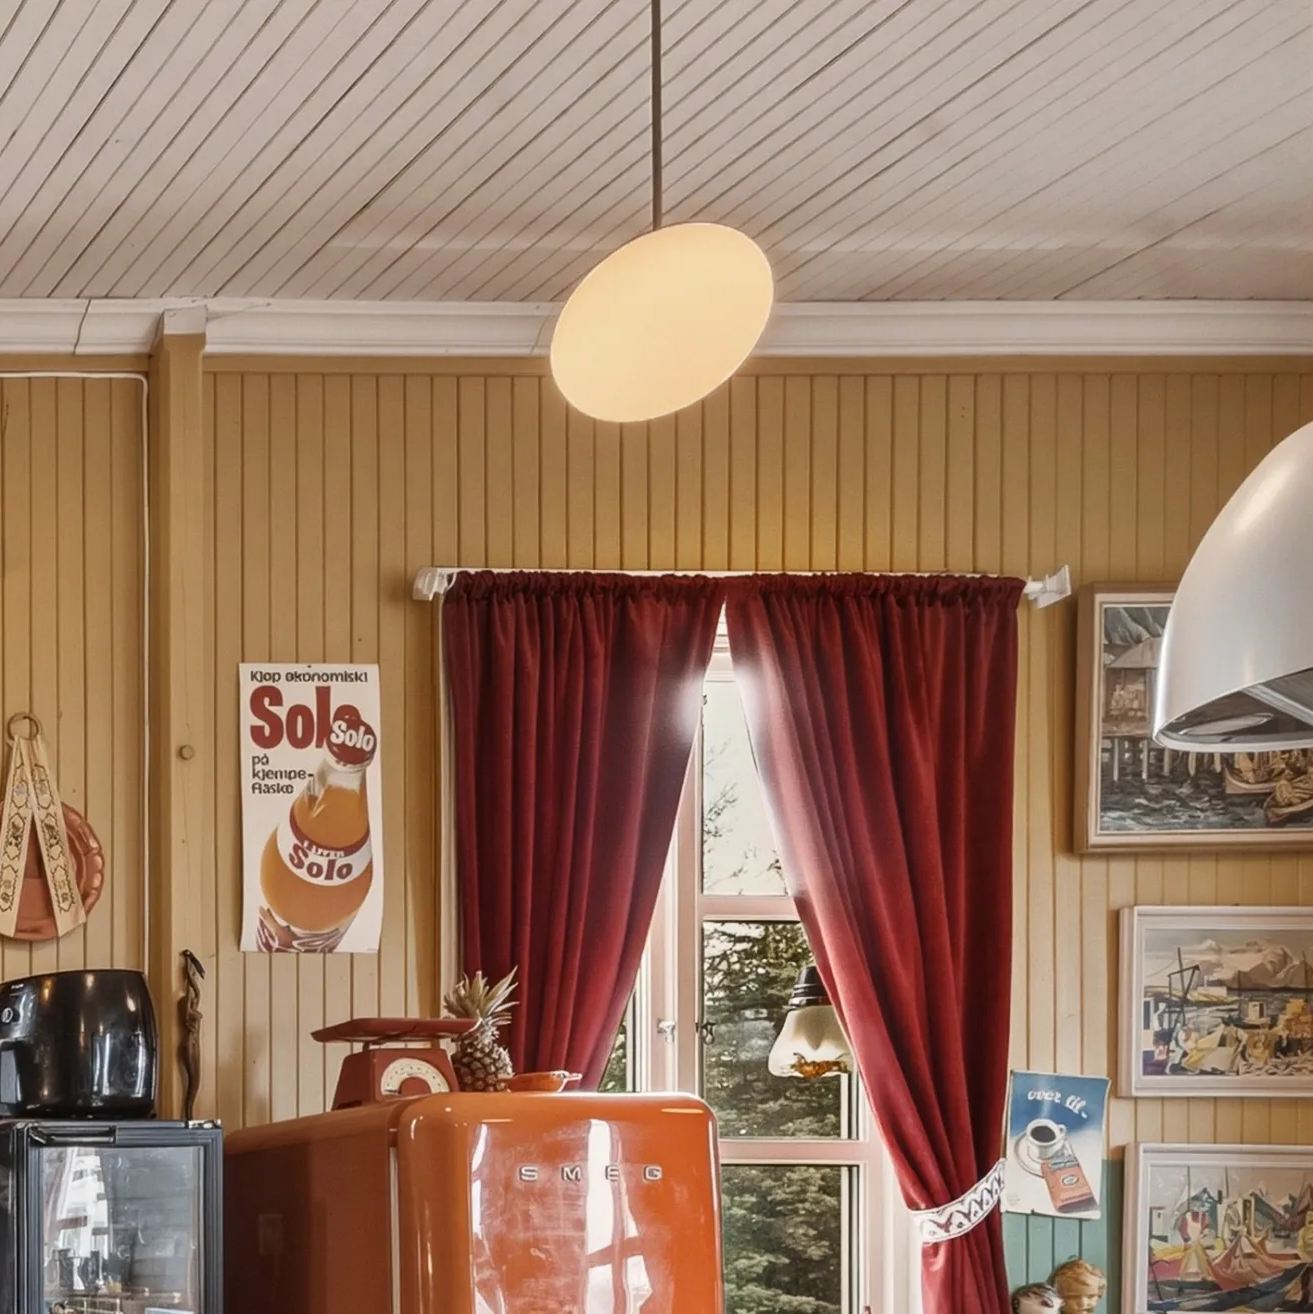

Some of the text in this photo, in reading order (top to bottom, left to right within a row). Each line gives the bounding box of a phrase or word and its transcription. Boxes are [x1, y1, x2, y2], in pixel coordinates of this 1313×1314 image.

[330, 720, 374, 752] Solo
[251, 753, 270, 769] på
[289, 843, 353, 880] Solo
[519, 1165, 663, 1182] SMEG
